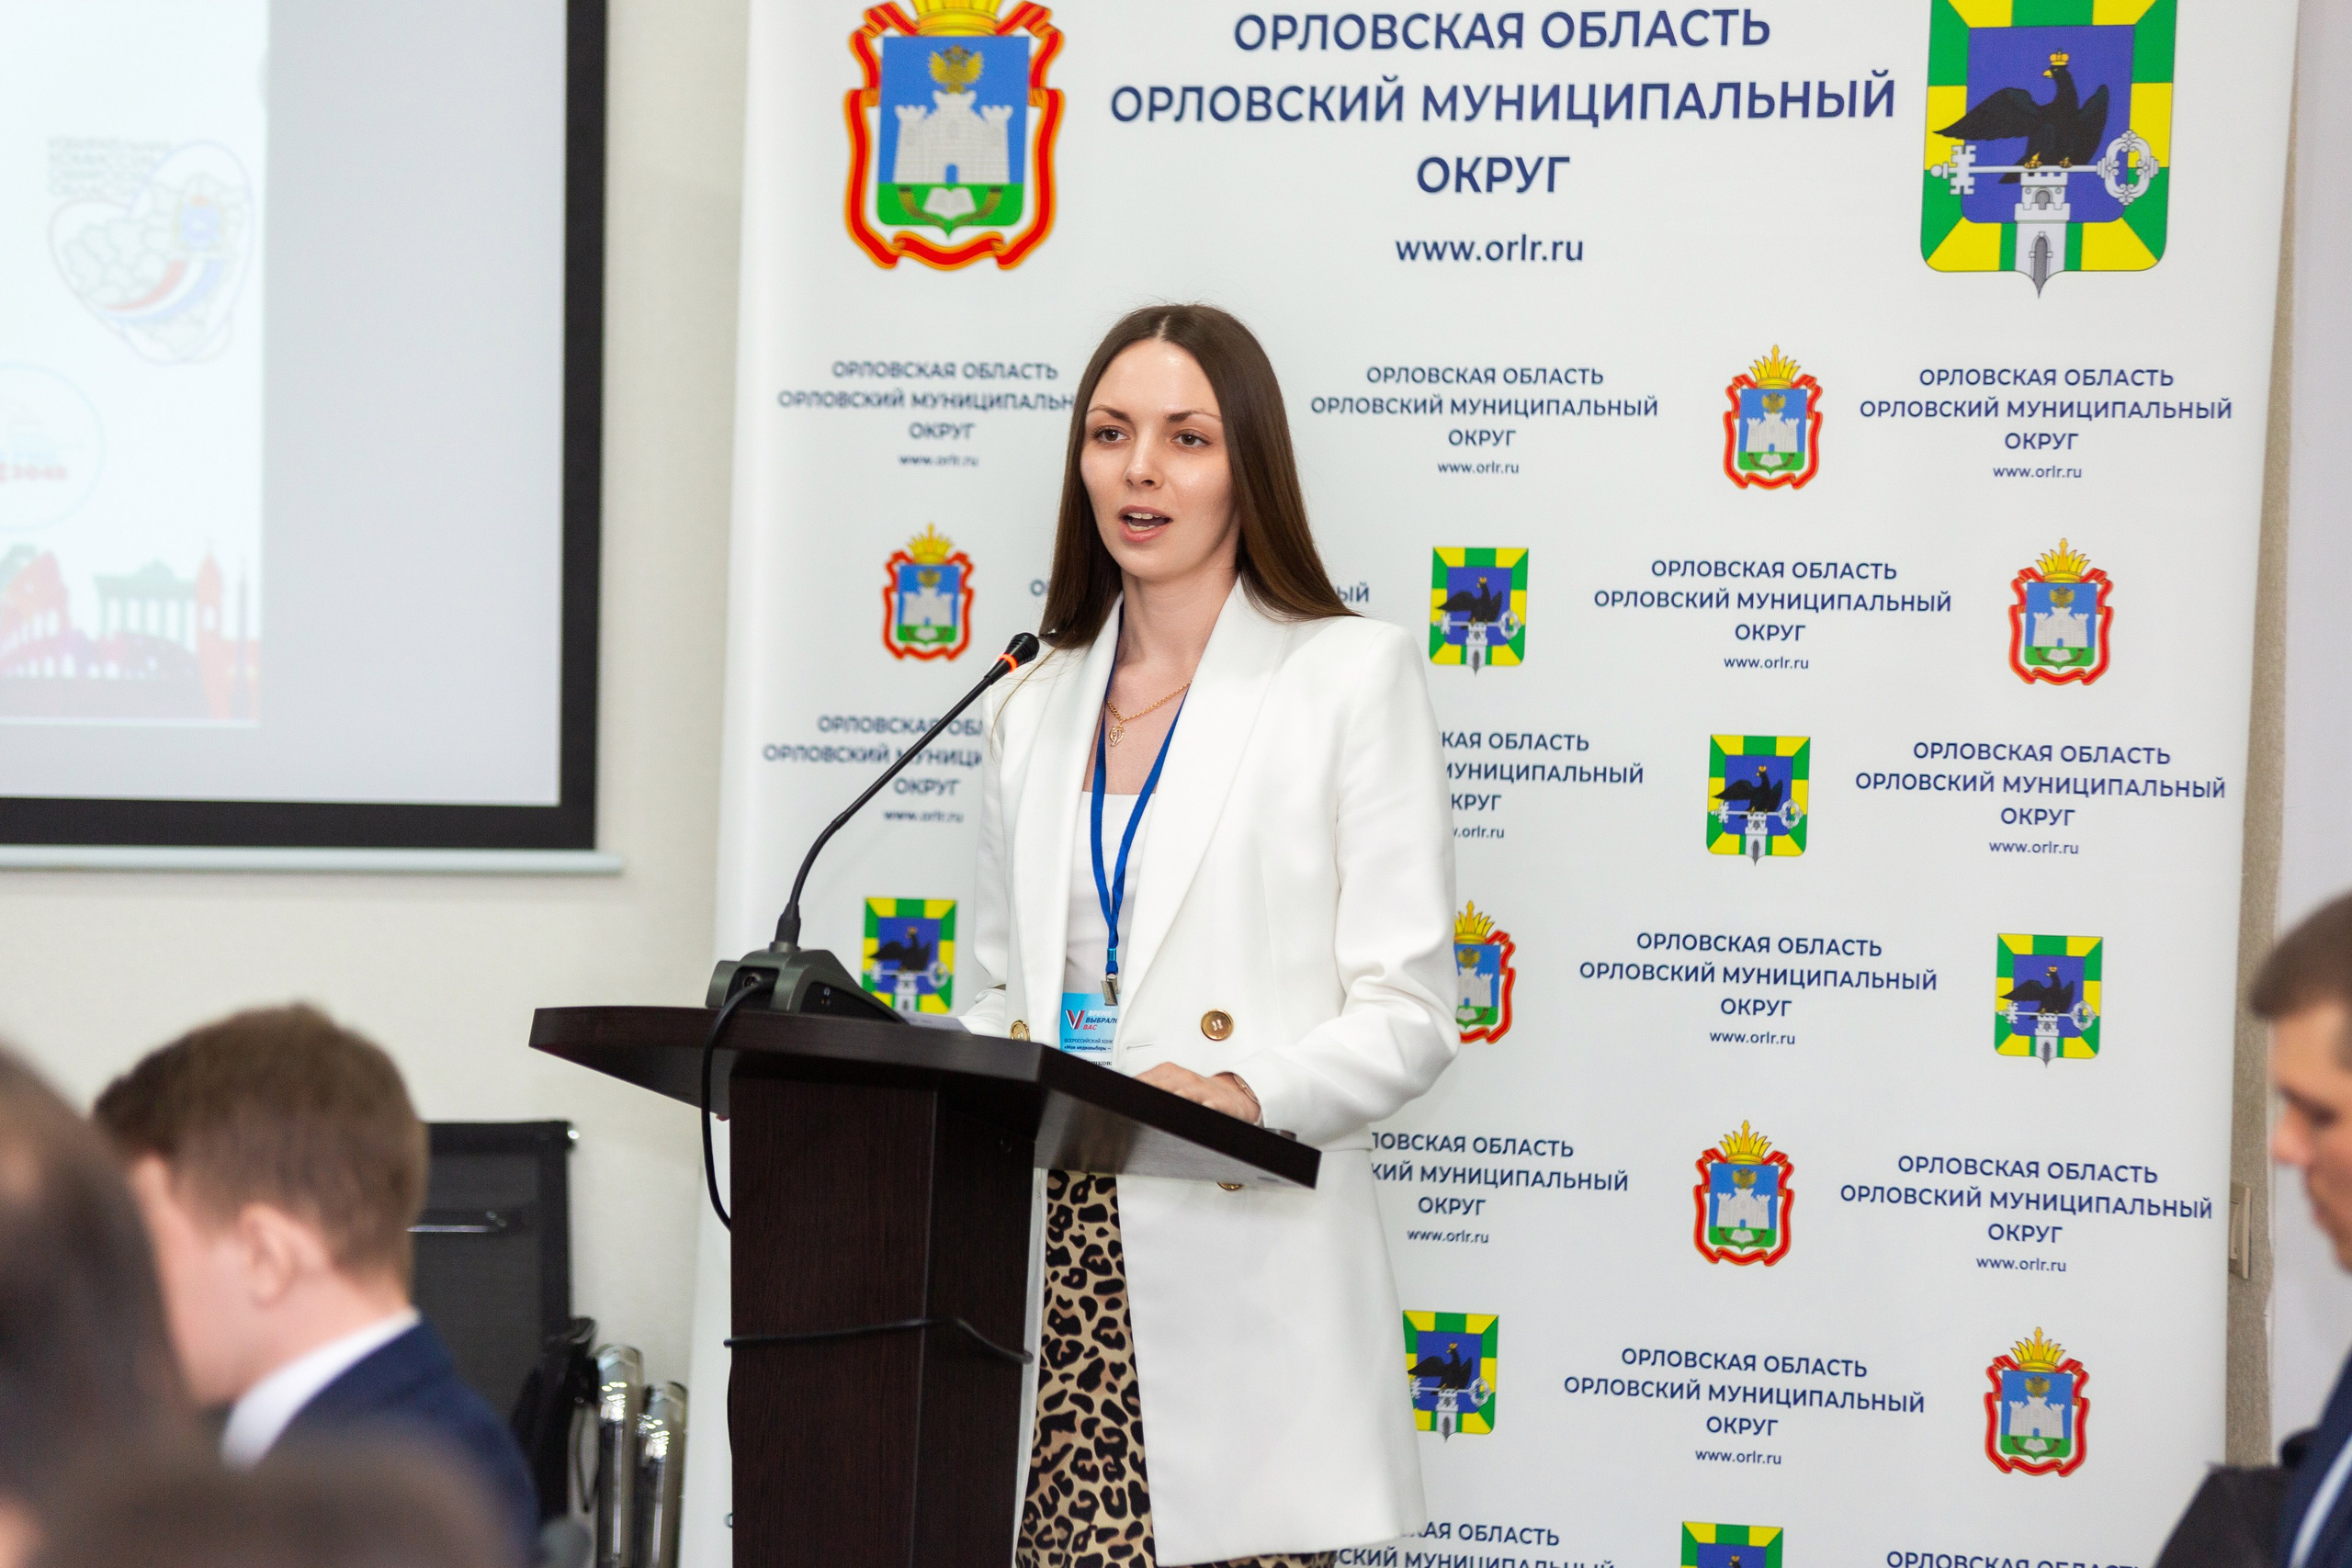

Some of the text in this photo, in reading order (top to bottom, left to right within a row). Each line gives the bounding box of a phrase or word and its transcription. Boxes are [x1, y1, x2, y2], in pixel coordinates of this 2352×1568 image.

[1234, 8, 1770, 51] ОРЛОВСКАЯ ОБЛАСТЬ
[1110, 69, 1895, 129] ОРЛОВСКИЙ МУНИЦИПАЛЬНЫЙ
[1417, 156, 1571, 195] ОКРУГ
[1395, 233, 1584, 262] www.orlr.ru
[831, 361, 1059, 380] ОРЛОВСКАЯ ОБЛАСТЬ
[1366, 367, 1604, 385] ОРЛОВСКАЯ ОБЛАСТЬ
[1919, 368, 2175, 387] ОРЛОВСКАЯ ОБЛАСТЬ
[779, 387, 1073, 412] ОРЛОВСКИЙ МУНИЦИПАЛЬН
[1310, 394, 1658, 419] ОРЛОВСКИЙ МУНИЦИПАЛЬНЫЙ
[1860, 396, 2232, 422] ОРЛОВСКИЙ МУНИЦИПАЛЬНЫЙ
[909, 422, 976, 439] ОКРУГ
[1448, 429, 1517, 446] ОКРУГ
[2004, 432, 2079, 450] ОКРУГ
[1437, 461, 1520, 474] www.orlr.ru
[1993, 465, 2082, 479] www.orlr.ru
[1651, 559, 1897, 581] ОРЛОВСКАЯ ОБЛАСТЬ
[1593, 587, 1951, 614] ОРЛОВСКИЙ МУНИЦИПАЛЬНЫЙ
[1735, 623, 1806, 642] ОКРУГ
[1724, 656, 1809, 670] www.orlr.ru
[1488, 732, 1589, 751] ОБЛАСТЬ
[1913, 741, 2171, 765] ОРЛОВСКАЯ ОБЛАСТЬ
[893, 778, 961, 796] ОКРУГ
[1855, 770, 2225, 798] ОРЛОВСКИЙ МУНИЦИПАЛЬНЫЙ
[1451, 793, 1502, 812] КРУГ
[2000, 807, 2076, 827] ОКРУГ
[1453, 825, 1505, 839] .orlr.ru
[1988, 840, 2079, 855] www.orlr.ru
[1636, 931, 1883, 957] ОРЛОВСКАЯ ОБЛАСТЬ
[1579, 961, 1938, 991] ОРЛОВСКИЙ МУНИЦИПАЛЬНЫЙ
[1720, 997, 1792, 1017] ОКРУГ
[1709, 1031, 1796, 1045] www.orlr.ru
[1371, 1132, 1575, 1157] ЛОВСКАЯ ОБЛАСТЬ
[1420, 1164, 1629, 1192] МУНИЦИПАЛЬНЫЙ
[1897, 1155, 2158, 1184] ОРЛОВСКАЯ ОБЛАСТЬ
[1417, 1195, 1487, 1216] ОКРУГ
[1840, 1184, 2212, 1220] ОРЛОВСКИЙ МУНИЦИПАЛЬНЫЙ
[1407, 1229, 1489, 1244] www.orlr.ru
[1987, 1223, 2064, 1244] ОКРУГ
[1975, 1258, 2067, 1272] www.orlr.ru
[1621, 1347, 1868, 1378] ОРЛОВСКАЯ ОБЛАСТЬ
[1564, 1375, 1925, 1414] ОРЛОВСКИЙ МУНИЦИПАЛЬНЫЙ
[1705, 1416, 1779, 1437] ОКРУГ
[1694, 1450, 1782, 1465] www.orlr.ru
[1458, 1522, 1560, 1547] ОБЛАСТЬ
